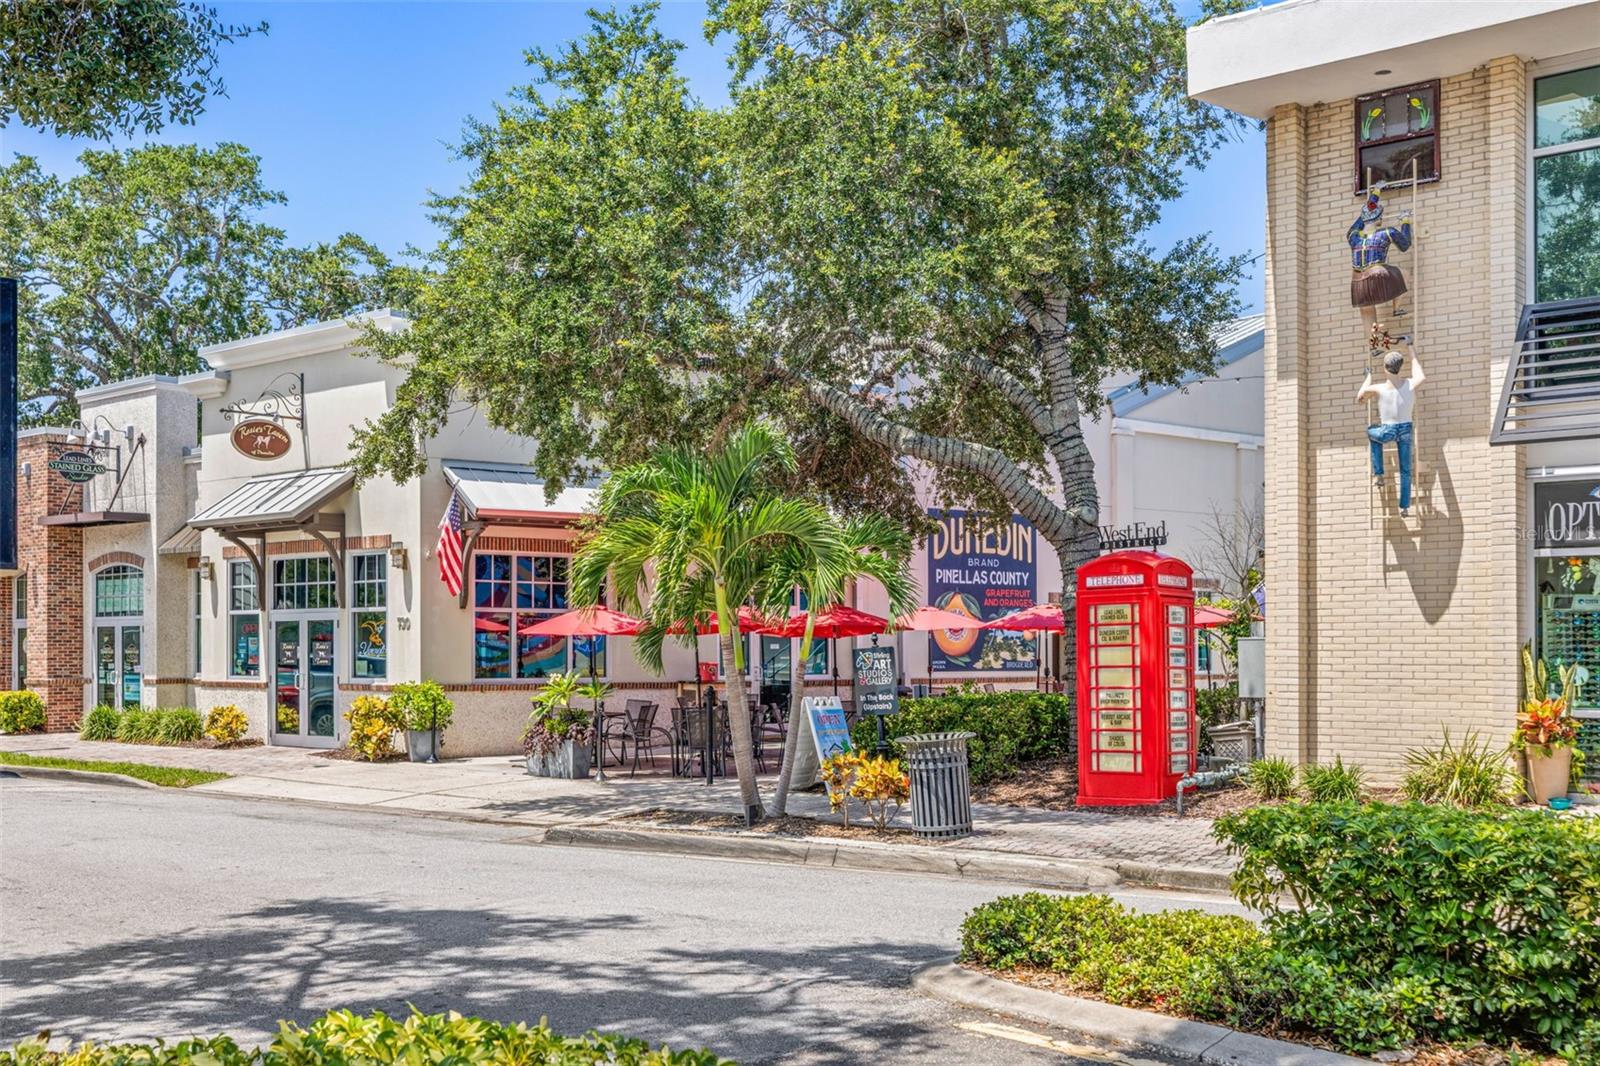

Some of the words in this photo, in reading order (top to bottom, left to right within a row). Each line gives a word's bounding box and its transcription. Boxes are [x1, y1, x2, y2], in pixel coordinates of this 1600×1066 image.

[49, 461, 82, 471] STAINED
[82, 463, 106, 473] GLASS
[933, 516, 1032, 564] DUNEDIN
[1104, 537, 1162, 549] DISTRICT
[967, 558, 1000, 568] BRAND
[935, 568, 988, 585] PINELLAS
[989, 570, 1030, 586] COUNTY
[1090, 575, 1142, 587] TELEPHONE
[985, 588, 1031, 598] GRAPEFRUIT
[983, 598, 999, 607] AND
[1000, 599, 1034, 608] ORANGES
[873, 659, 891, 670] ART
[858, 669, 893, 678] STUDIOS
[879, 693, 894, 701] Back
